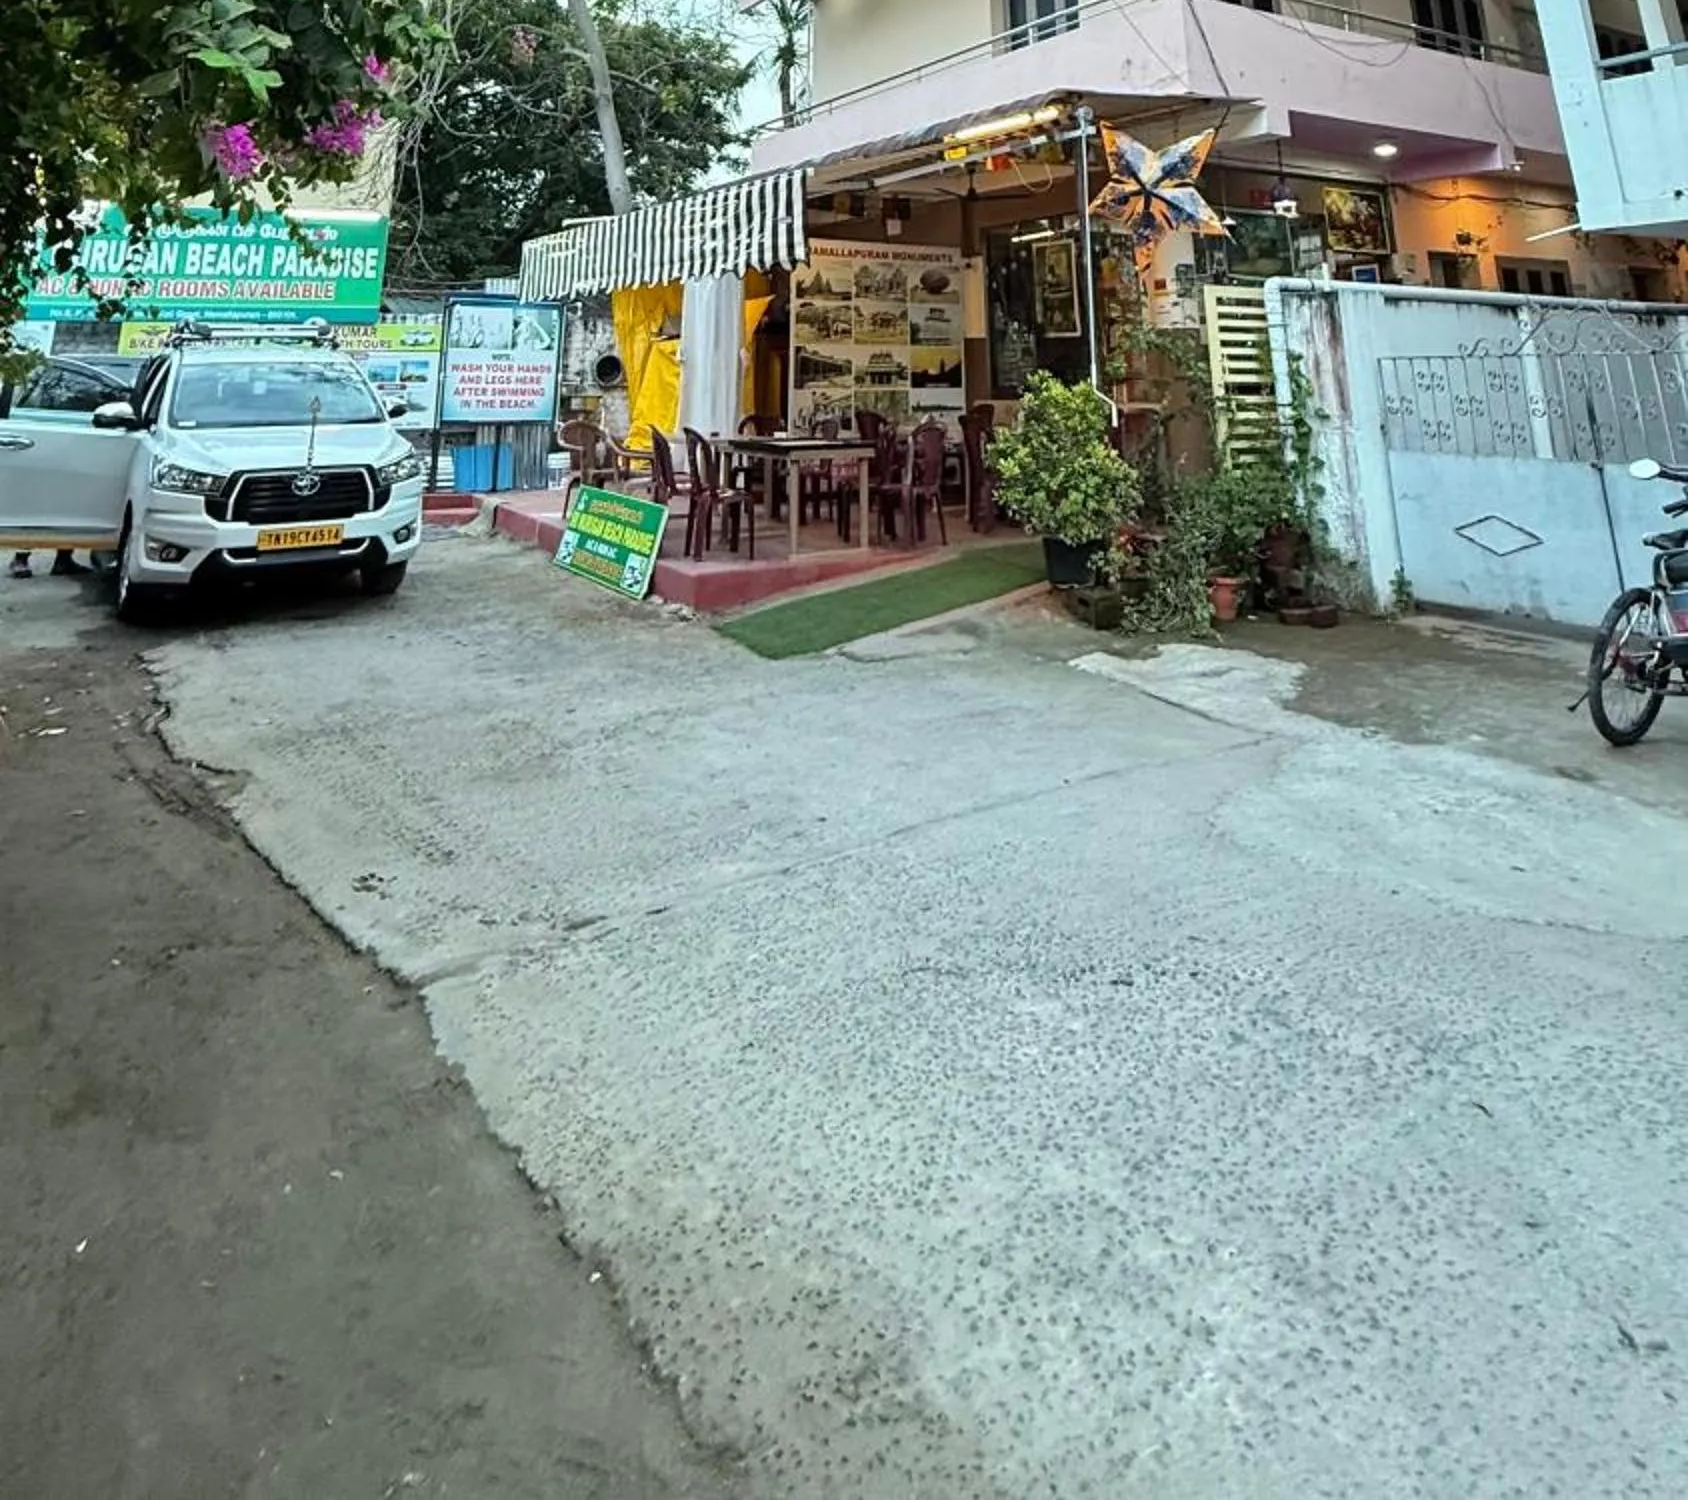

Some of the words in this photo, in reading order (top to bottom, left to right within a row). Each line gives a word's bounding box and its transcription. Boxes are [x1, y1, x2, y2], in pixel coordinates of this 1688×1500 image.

[812, 246, 889, 261] AMALLAPURAM
[185, 243, 265, 276] BEACH
[270, 245, 379, 279] PARADISE
[36, 278, 63, 296] AC
[158, 280, 229, 298] ROOMS
[233, 281, 335, 300] AVAILABLE
[451, 364, 482, 373] WASH
[486, 364, 514, 373] YOUR
[517, 364, 552, 373] HANDS
[460, 376, 482, 385] AND
[485, 376, 513, 385] LEGS
[516, 376, 542, 385] HERE
[454, 387, 488, 397] AFTER
[491, 388, 545, 397] SWIMMING
[461, 400, 471, 409] IN
[476, 400, 496, 409] THE
